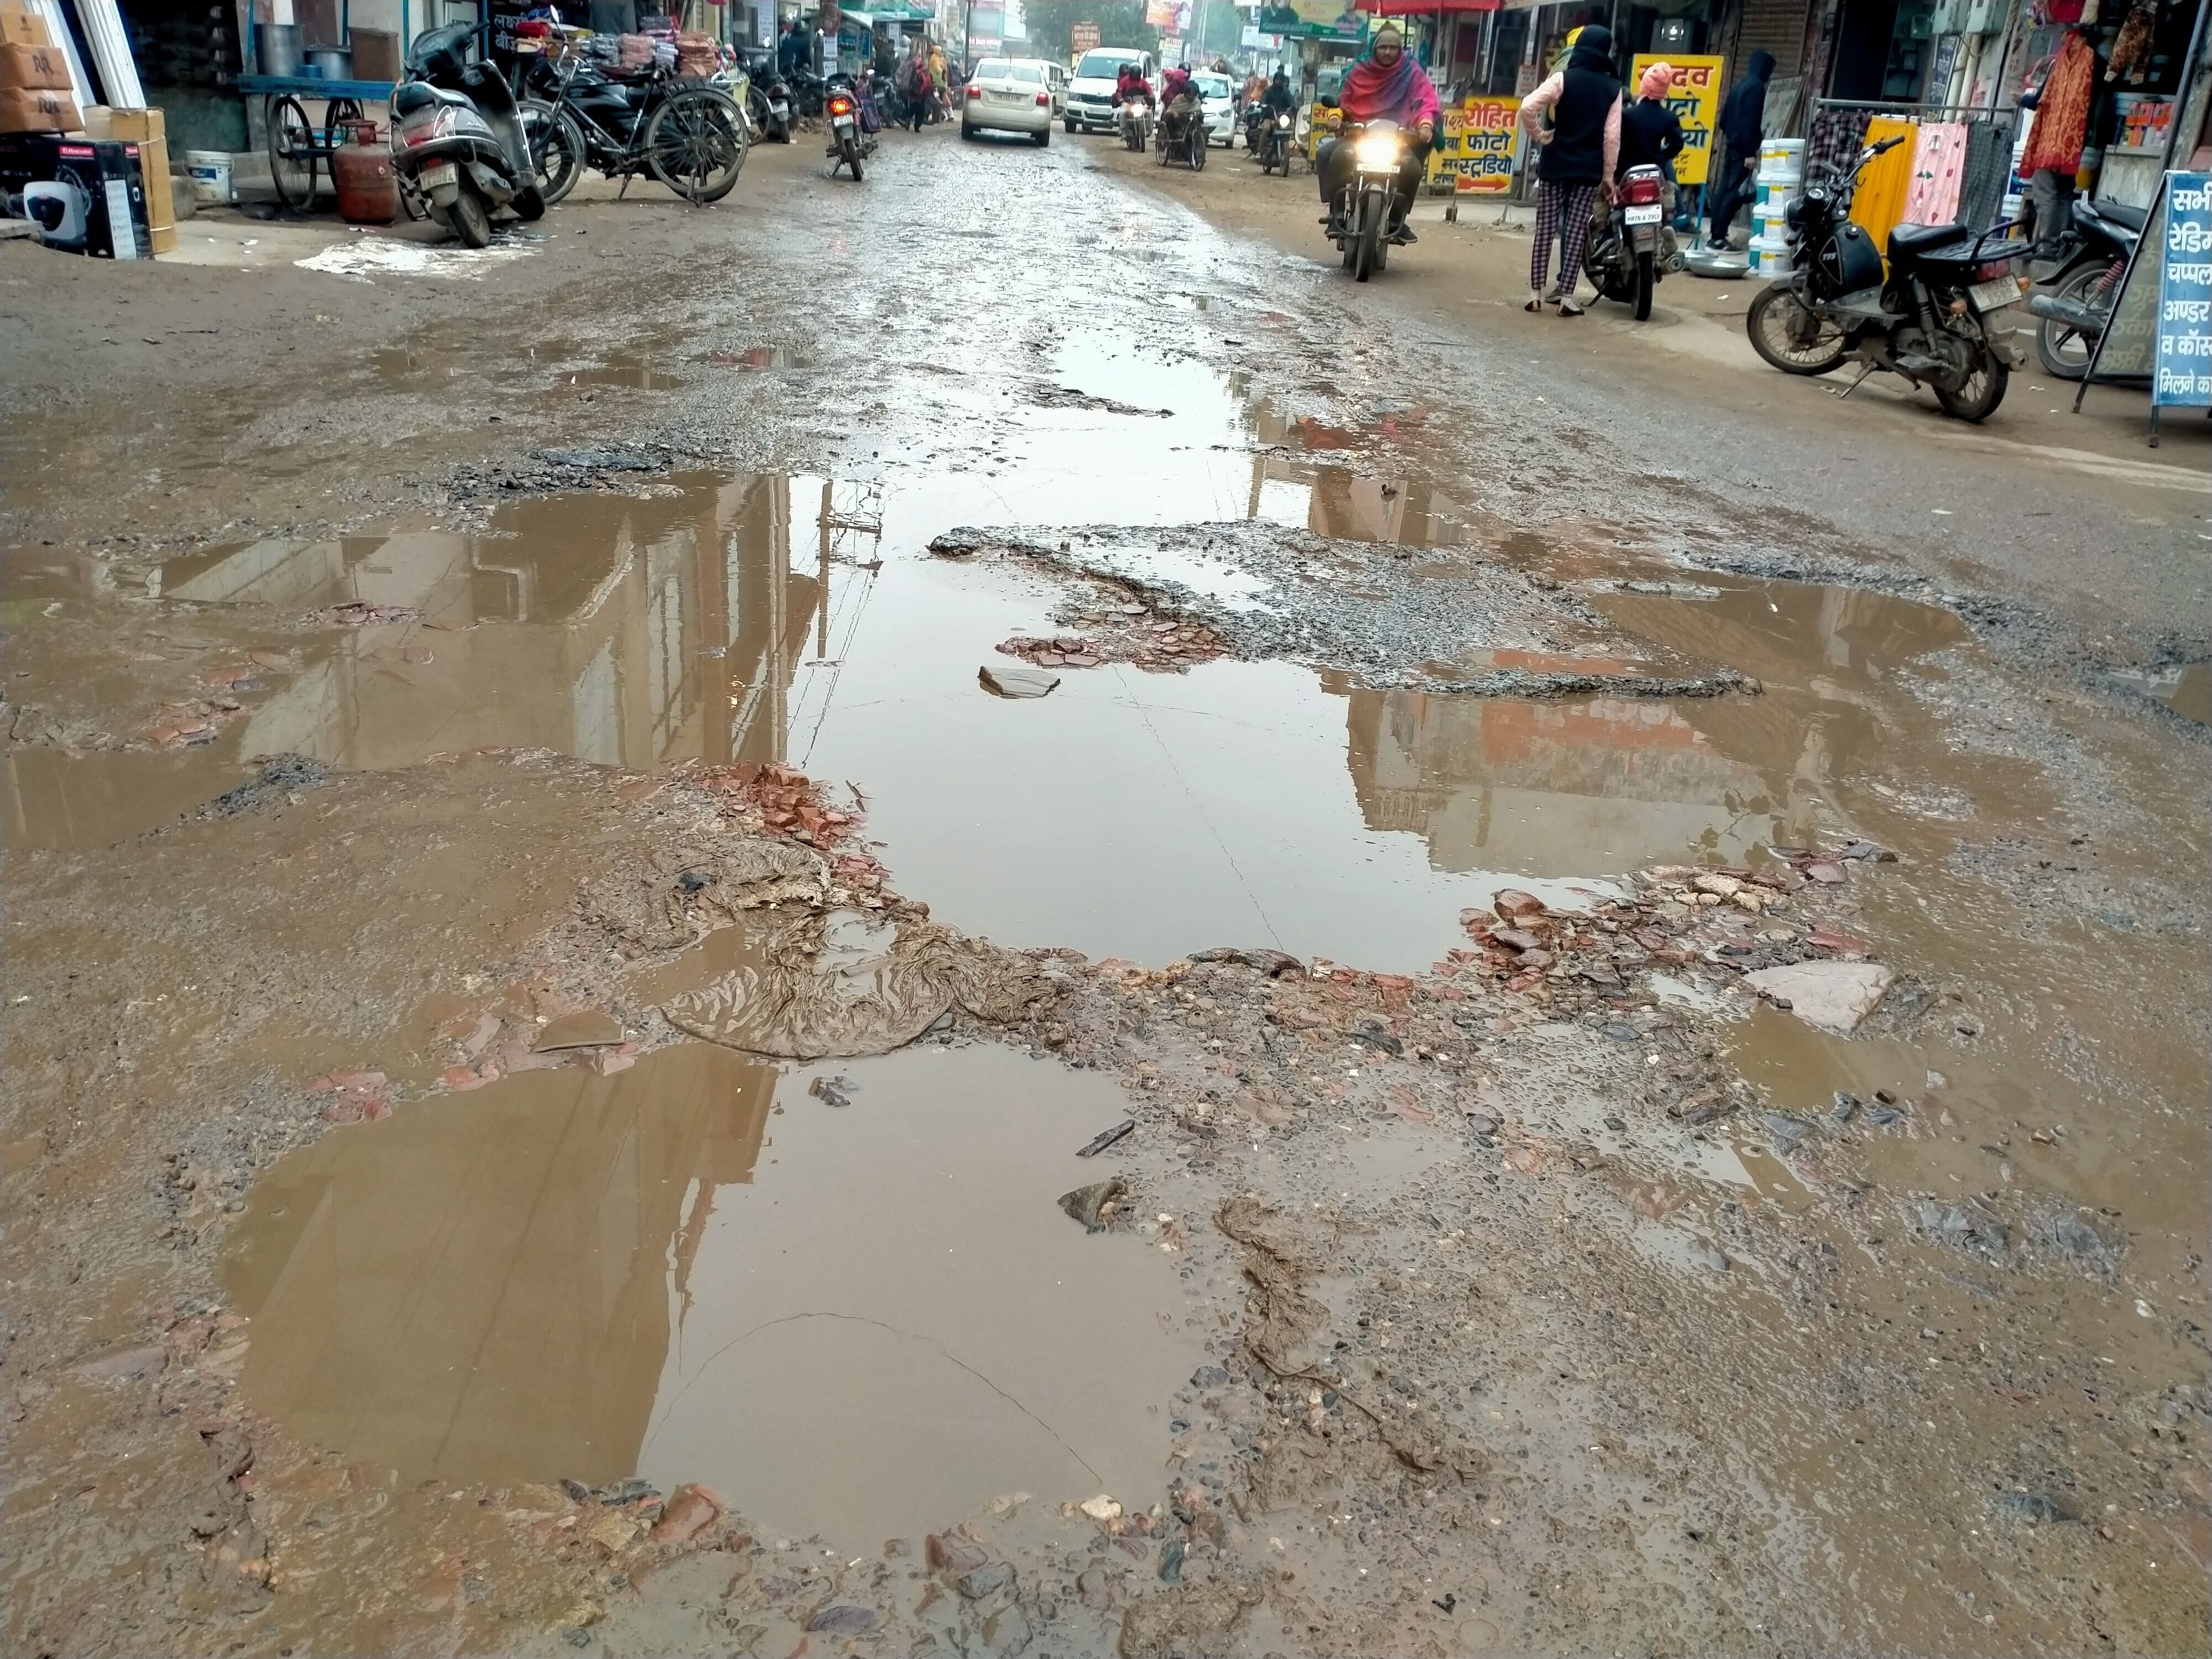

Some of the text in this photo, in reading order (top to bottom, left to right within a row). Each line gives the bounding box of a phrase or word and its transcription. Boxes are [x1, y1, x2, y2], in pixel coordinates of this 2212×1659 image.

[1464, 101, 1518, 129] रोहित
[1467, 130, 1511, 151] फोटो
[1822, 252, 1837, 261] TVS
[2163, 300, 2211, 323] अण्डर
[2162, 335, 2175, 356] व
[2159, 367, 2195, 395] मिलने
